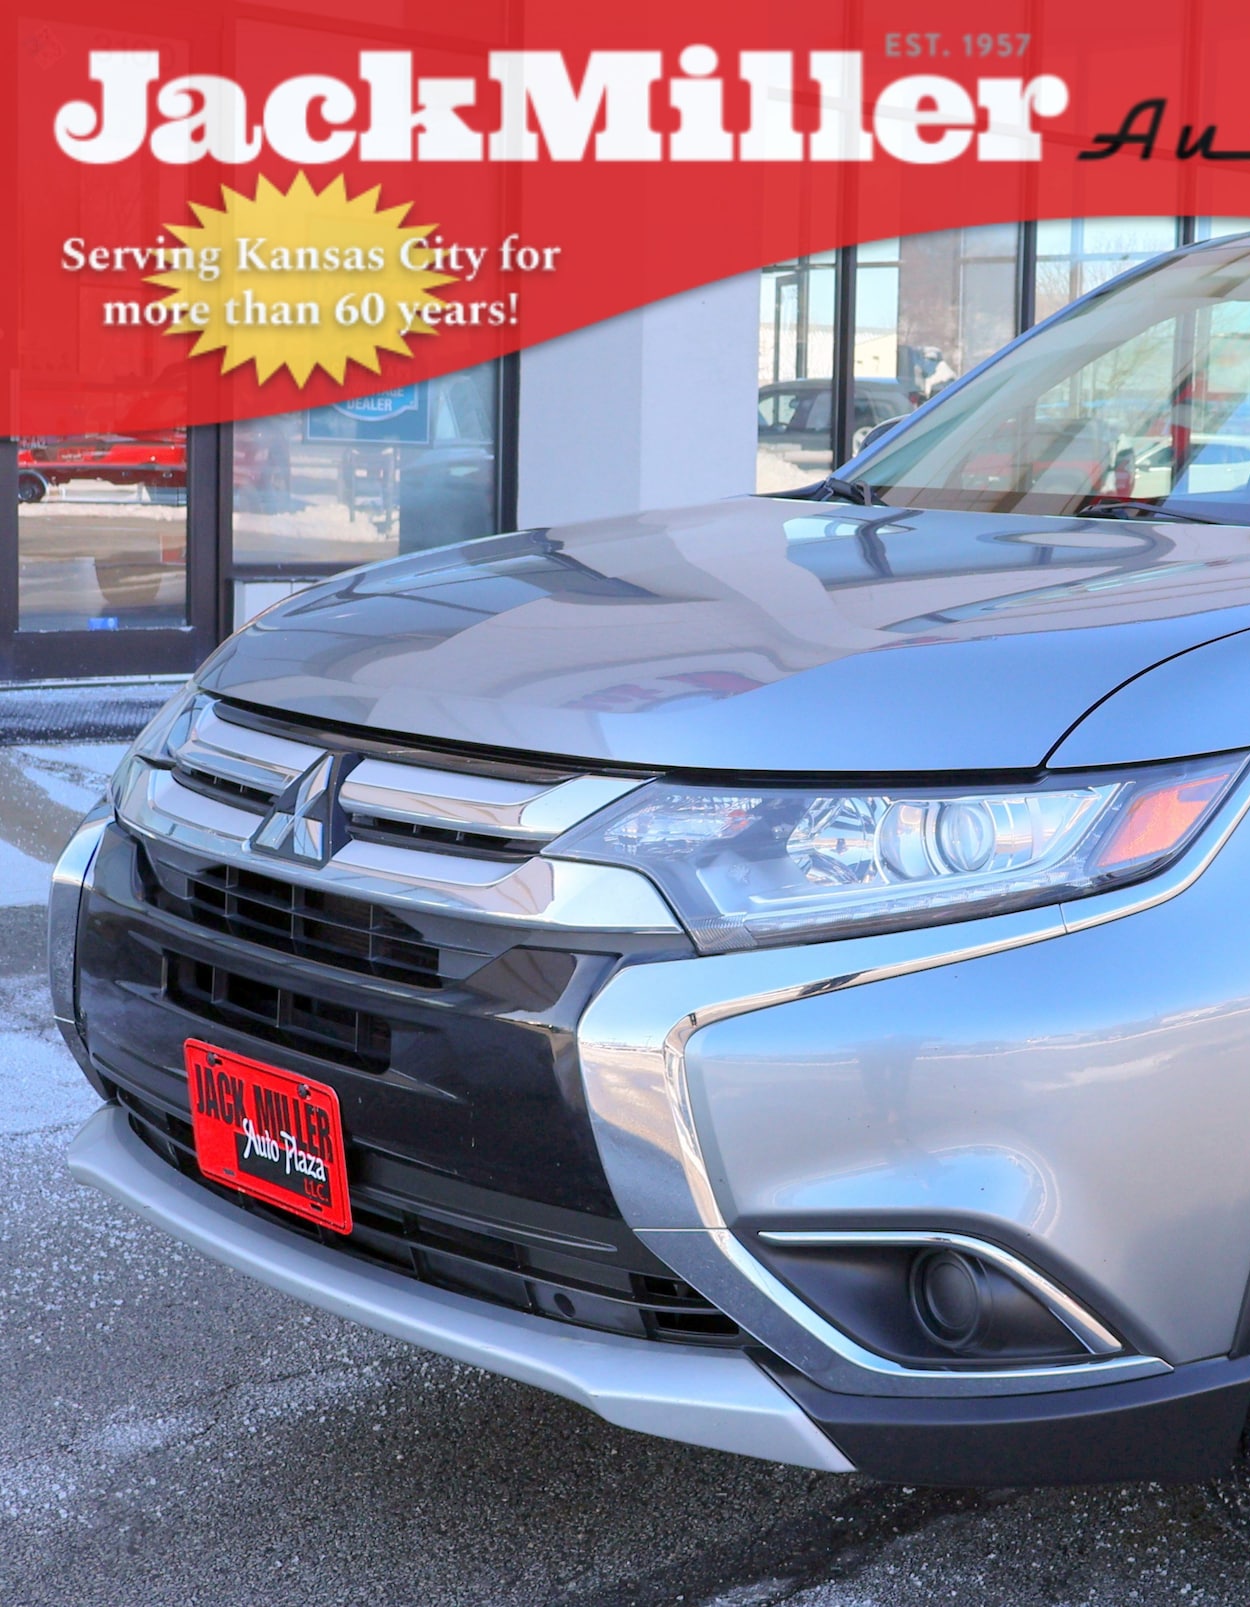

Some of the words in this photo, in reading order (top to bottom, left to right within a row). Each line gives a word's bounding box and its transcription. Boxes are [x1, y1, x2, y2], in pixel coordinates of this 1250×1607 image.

[195, 1064, 248, 1128] JACK
[252, 1084, 335, 1164] MILLER
[242, 1117, 280, 1163] Auto
[280, 1130, 327, 1183] Plaza
